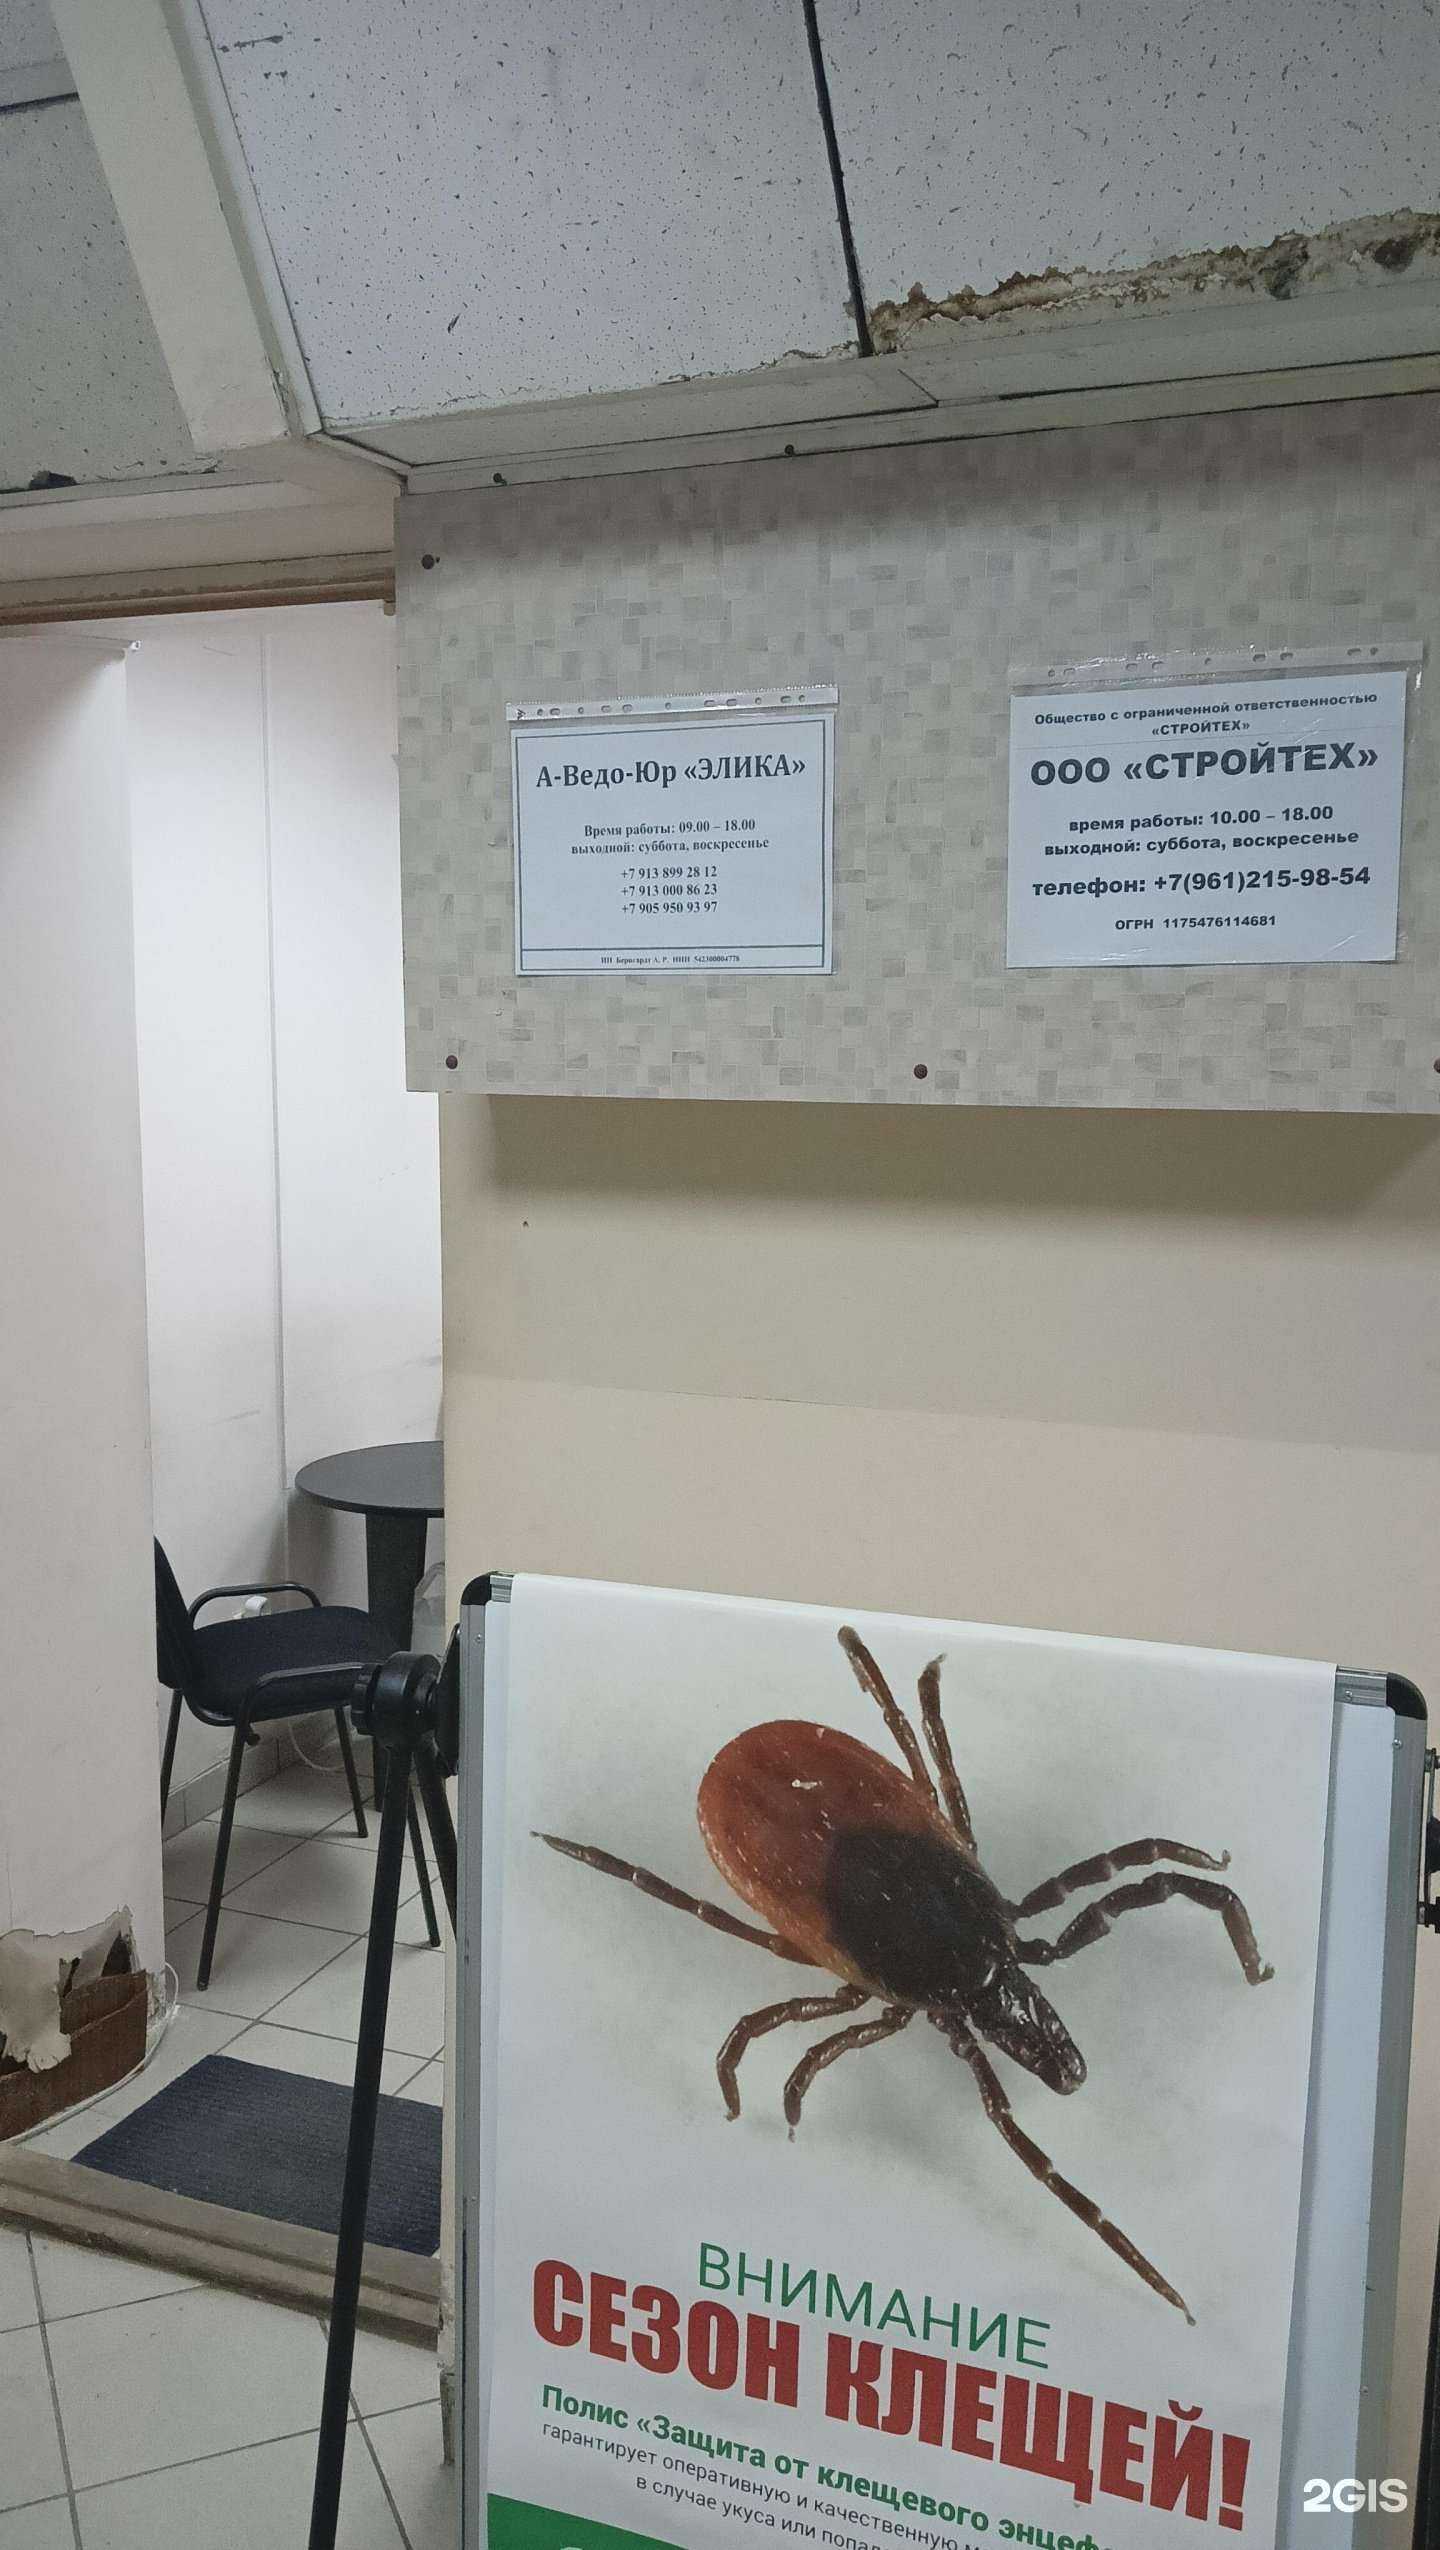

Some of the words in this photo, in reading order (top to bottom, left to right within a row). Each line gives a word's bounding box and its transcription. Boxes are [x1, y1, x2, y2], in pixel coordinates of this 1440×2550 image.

[1035, 710, 1105, 725] Общество
[1111, 712, 1118, 720] с
[1124, 703, 1229, 721] ограниченной
[1235, 693, 1377, 713] ответственностью
[1152, 720, 1250, 736] «СТРОЙТЕХ»
[536, 760, 676, 789] А-Ведо-Юр
[684, 754, 806, 780] «ЭЛИКА»
[1030, 758, 1110, 786] ООО
[1124, 741, 1377, 781] «СТРОЙТЕХ»
[584, 825, 622, 839] Время
[626, 823, 675, 837] работы:
[679, 821, 710, 833] 09.00
[724, 819, 756, 832] 18.00
[1069, 817, 1124, 833] время
[1131, 813, 1203, 832] работы:
[1210, 810, 1260, 825] 10.00
[1282, 806, 1333, 822] 18.00
[571, 841, 635, 854] выходной:
[638, 840, 689, 855] суббота,
[693, 839, 769, 852] воскресенье
[1045, 839, 1141, 856] выходной:
[1146, 835, 1226, 853] суббота,
[1233, 830, 1358, 848] воскресенье
[621, 868, 635, 880] +7
[639, 867, 659, 879] 913
[663, 867, 683, 878] 899
[687, 866, 700, 878] 28
[704, 865, 718, 877] 12
[1032, 877, 1145, 897] телефон:
[1155, 867, 1370, 894] +7(961)215-98-54
[621, 886, 635, 898] +7
[639, 885, 659, 897] 913
[663, 885, 683, 896] 000
[687, 884, 700, 896] 86
[704, 883, 718, 895] 23
[621, 903, 635, 915] +7
[639, 902, 659, 914] 905
[663, 902, 683, 913] 950
[687, 901, 700, 913] 93
[704, 900, 718, 912] 97
[1115, 919, 1154, 930] ОГРН
[1162, 916, 1276, 929] 1175476114681
[699, 2242, 1052, 2370] ВНИМАНИЕ
[532, 2259, 799, 2408] СЕЗОН
[825, 2332, 1251, 2532] КЛЕЩЕЙ!
[542, 2384, 629, 2429] Полис
[637, 2415, 766, 2469] «Защита
[775, 2454, 810, 2479] от
[817, 2466, 989, 2532] клещевого
[998, 2518, 1113, 2550] энцеф
[542, 2423, 657, 2465] гарантирует
[663, 2455, 791, 2505] оперативную
[797, 2495, 808, 2509] и
[814, 2500, 958, 2550] качественную
[636, 2476, 647, 2490] в
[652, 2477, 717, 2511] случае
[722, 2500, 775, 2528] укуса
[782, 2518, 816, 2538] или
